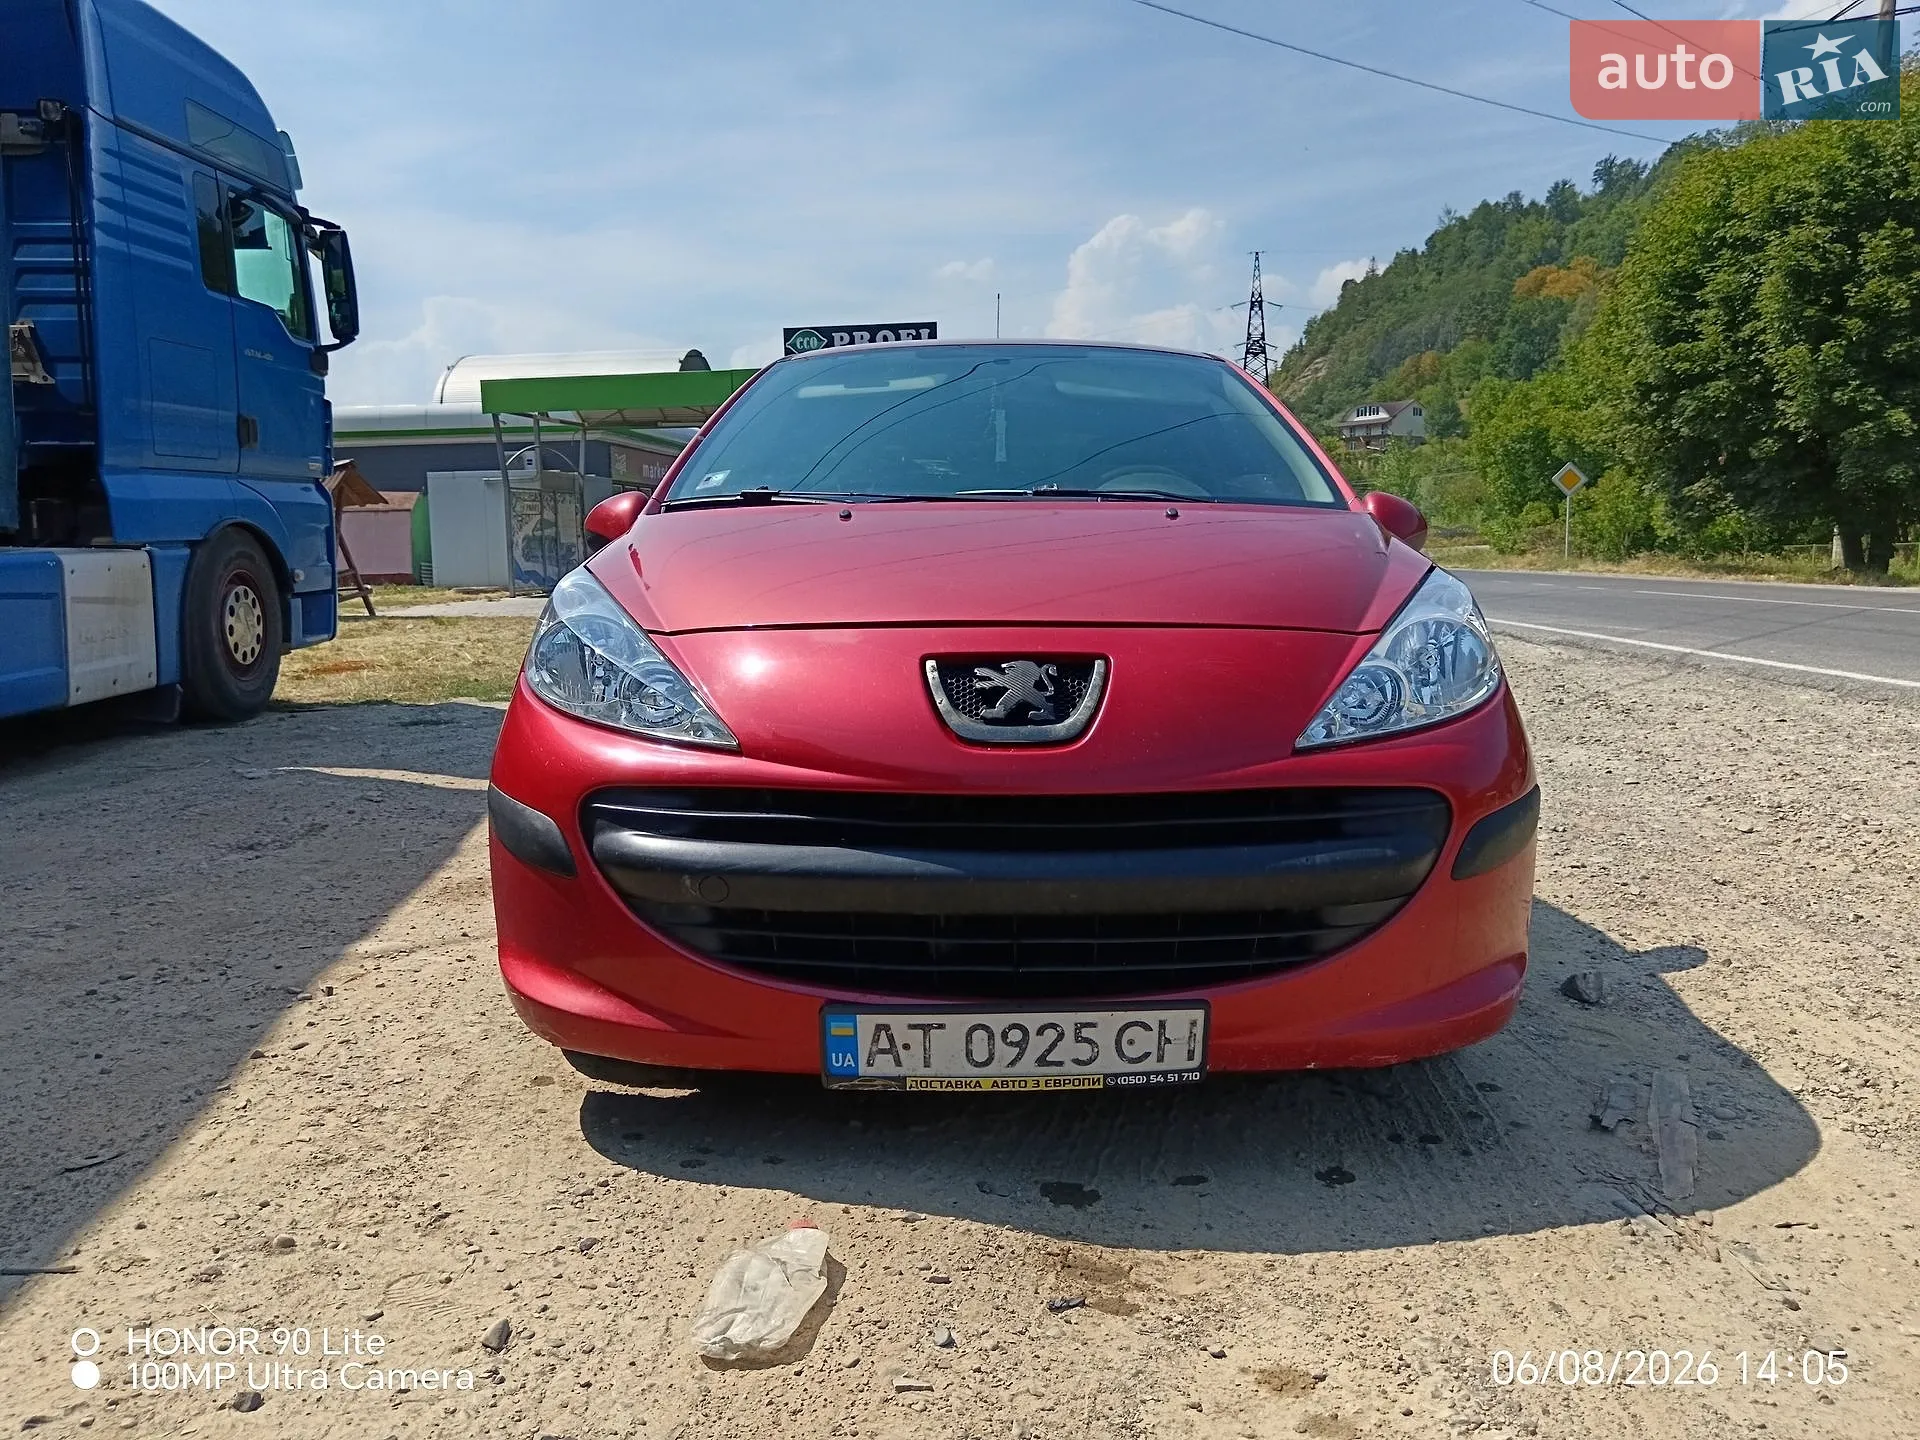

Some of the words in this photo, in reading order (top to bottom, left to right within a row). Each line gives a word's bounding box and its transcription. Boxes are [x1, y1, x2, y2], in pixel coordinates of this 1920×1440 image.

[796, 336, 818, 349] eco
[642, 460, 669, 479] marke
[866, 1023, 947, 1068] AT
[965, 1022, 1100, 1068] 0925
[832, 1053, 855, 1067] UA
[909, 1079, 982, 1090] ДОСТАВКА
[991, 1079, 1027, 1089] АВТО
[1117, 1075, 1147, 1085] (050)
[1149, 1074, 1164, 1083] 54
[1167, 1073, 1179, 1082] 51
[1181, 1072, 1200, 1081] 710
